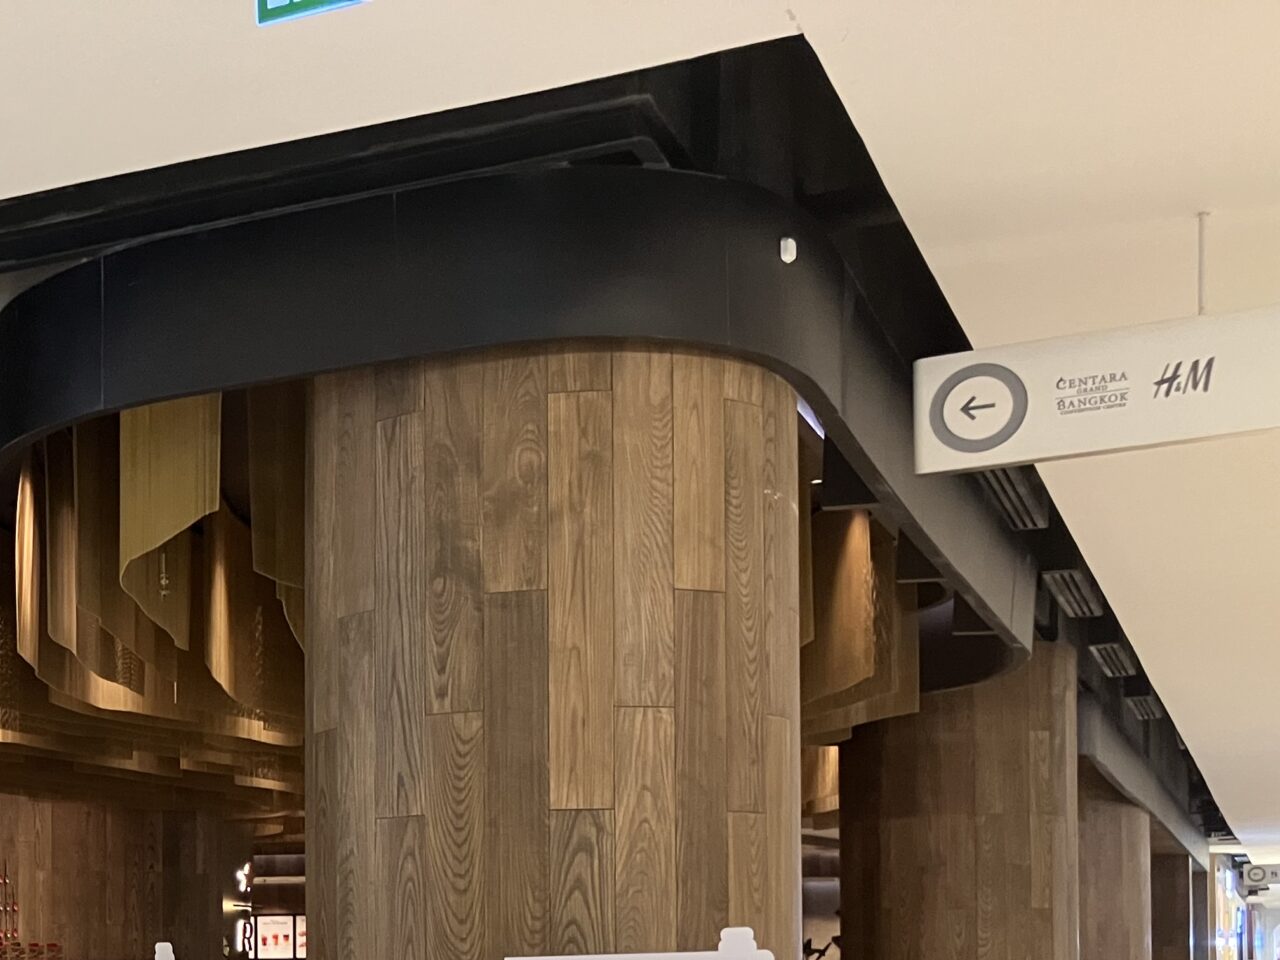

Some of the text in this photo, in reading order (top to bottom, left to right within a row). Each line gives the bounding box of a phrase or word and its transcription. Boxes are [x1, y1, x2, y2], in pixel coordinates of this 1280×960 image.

[1055, 371, 1128, 390] CENTARA
[1152, 356, 1215, 399] H&M
[1076, 385, 1108, 394] GRAND
[1056, 392, 1128, 411] BANGKOK
